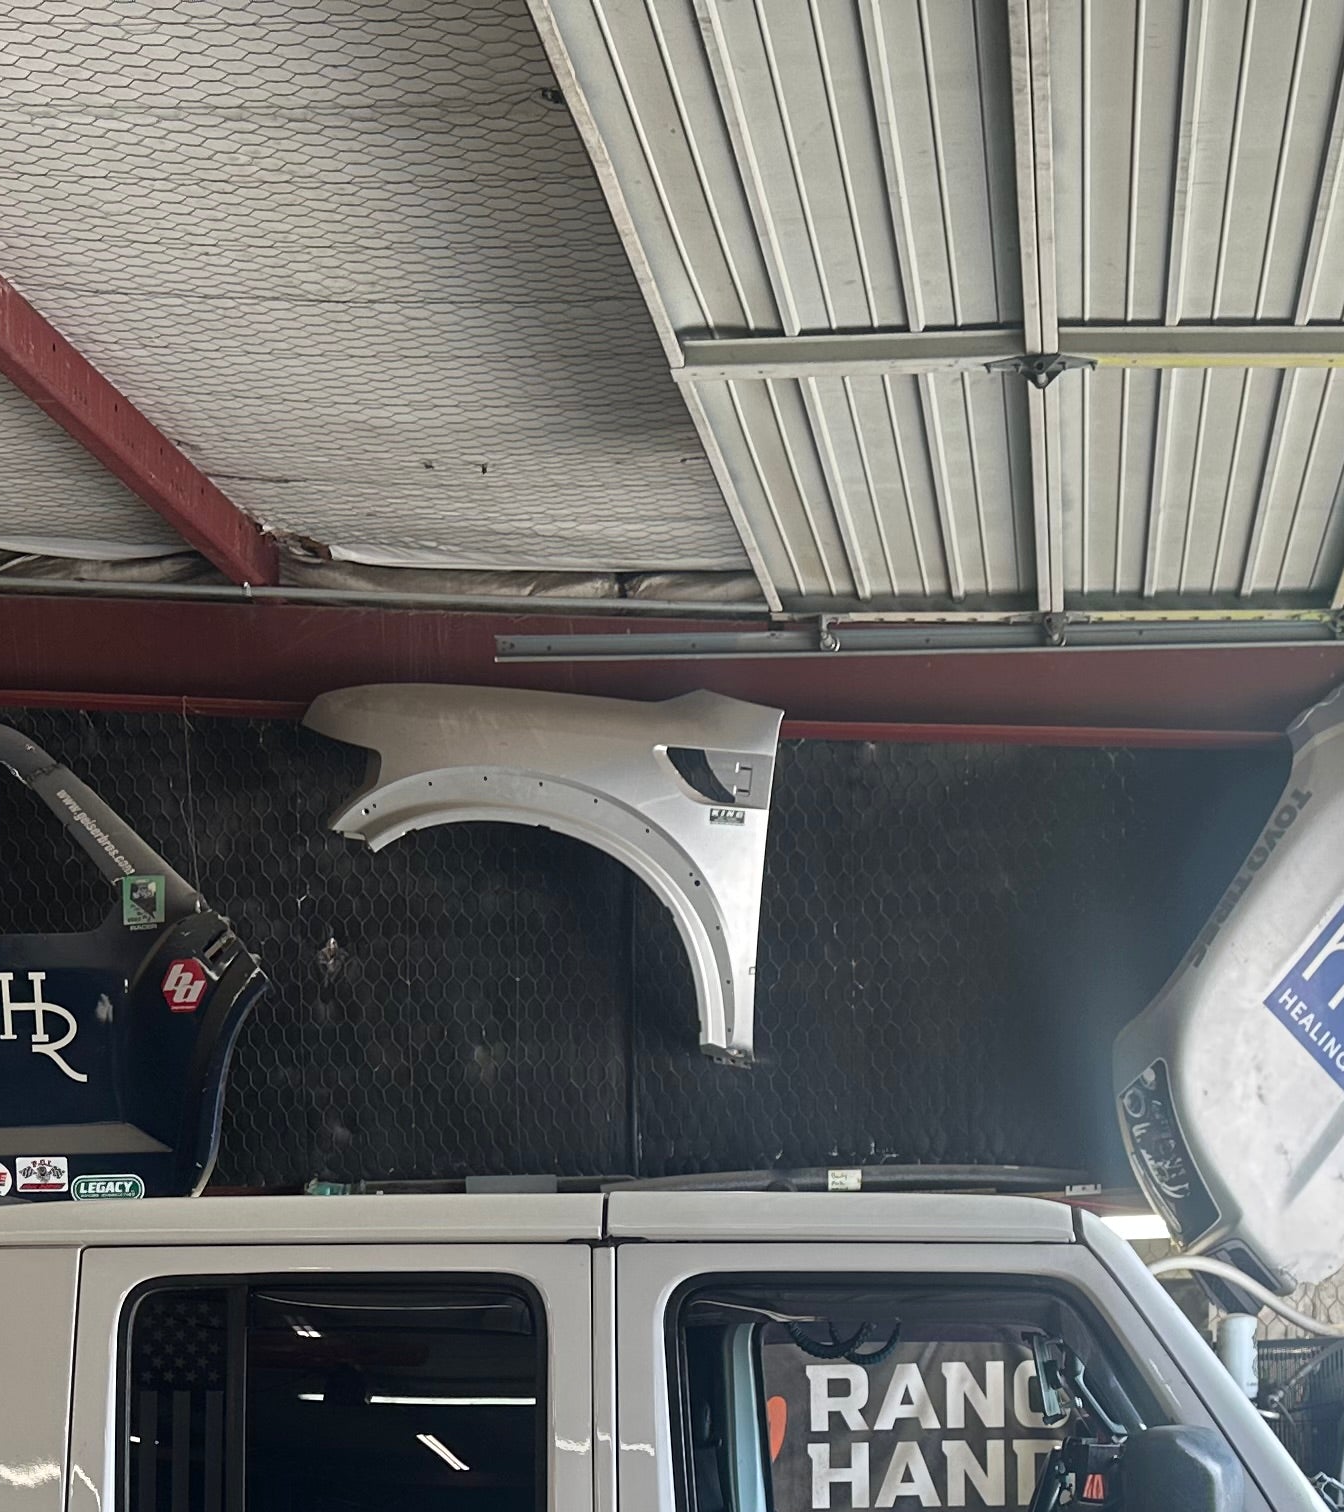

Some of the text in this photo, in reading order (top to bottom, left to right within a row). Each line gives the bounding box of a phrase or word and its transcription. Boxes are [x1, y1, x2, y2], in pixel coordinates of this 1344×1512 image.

[1185, 787, 1312, 968] TOYO TIRES
[79, 1180, 133, 1194] LEGACY
